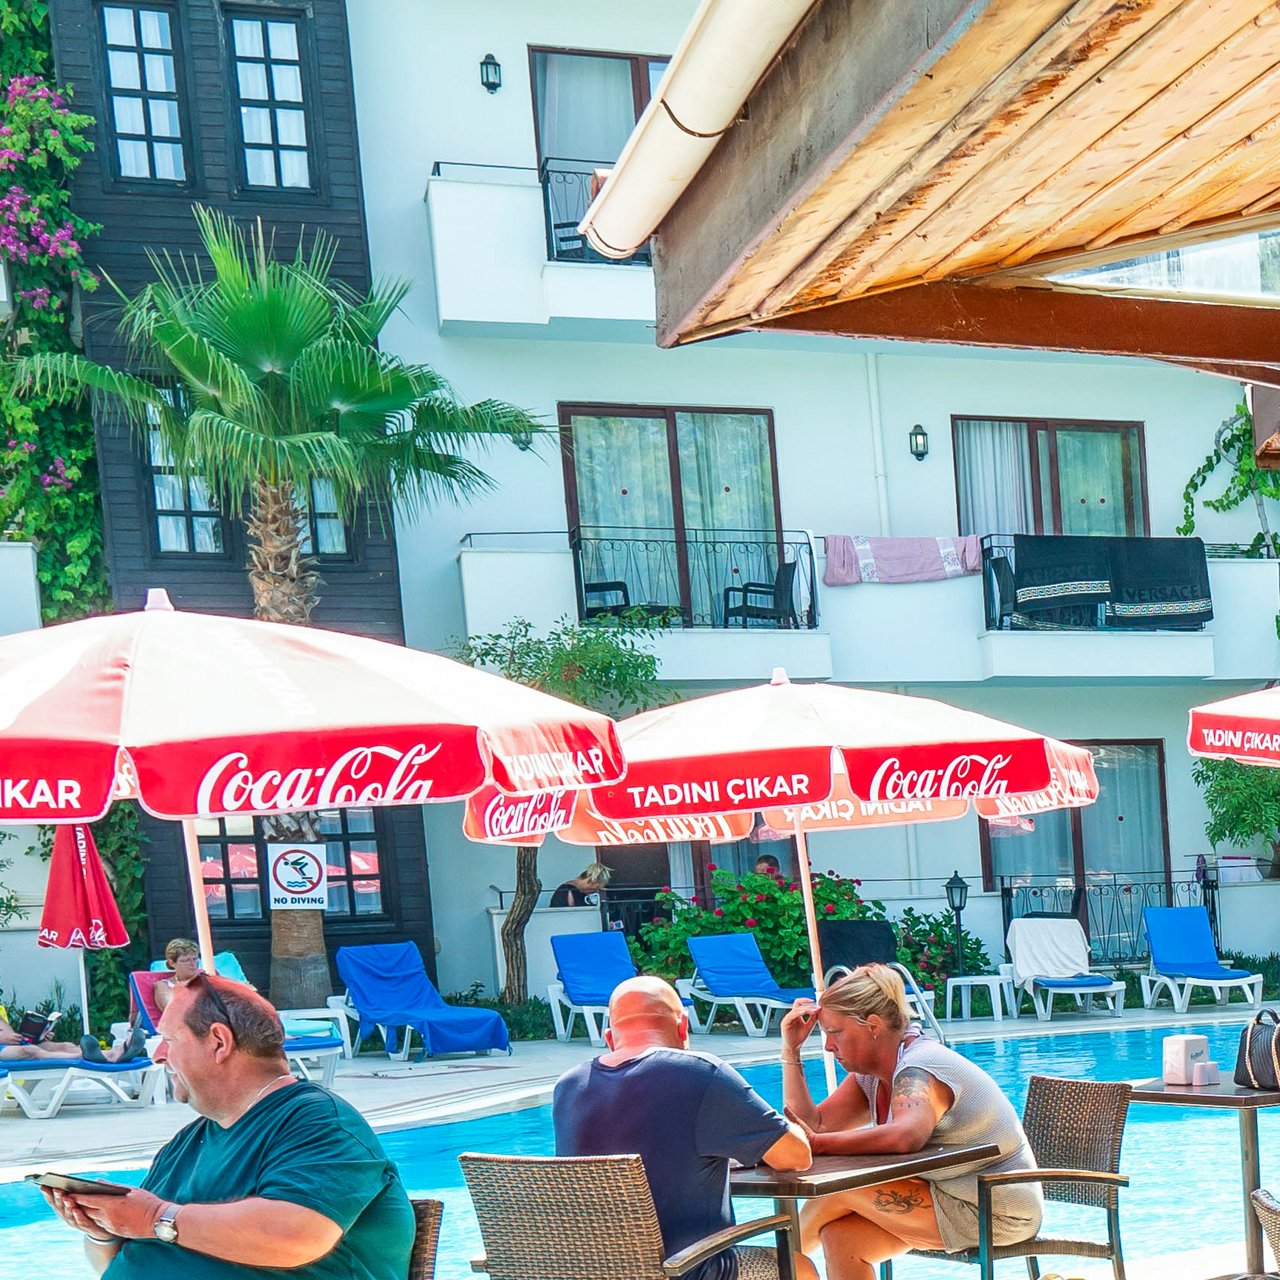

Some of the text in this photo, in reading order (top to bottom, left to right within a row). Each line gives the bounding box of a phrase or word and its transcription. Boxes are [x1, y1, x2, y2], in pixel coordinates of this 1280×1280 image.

[1125, 584, 1199, 602] VERSACE
[1202, 729, 1280, 752] TADINI ÇIKAR
[197, 743, 442, 814] Coca-Cola
[626, 774, 810, 809] TADINI ÇIKAR
[870, 754, 1012, 801] Coca-Cola
[0, 779, 81, 809] KAR
[273, 897, 325, 905] NO DIVING
